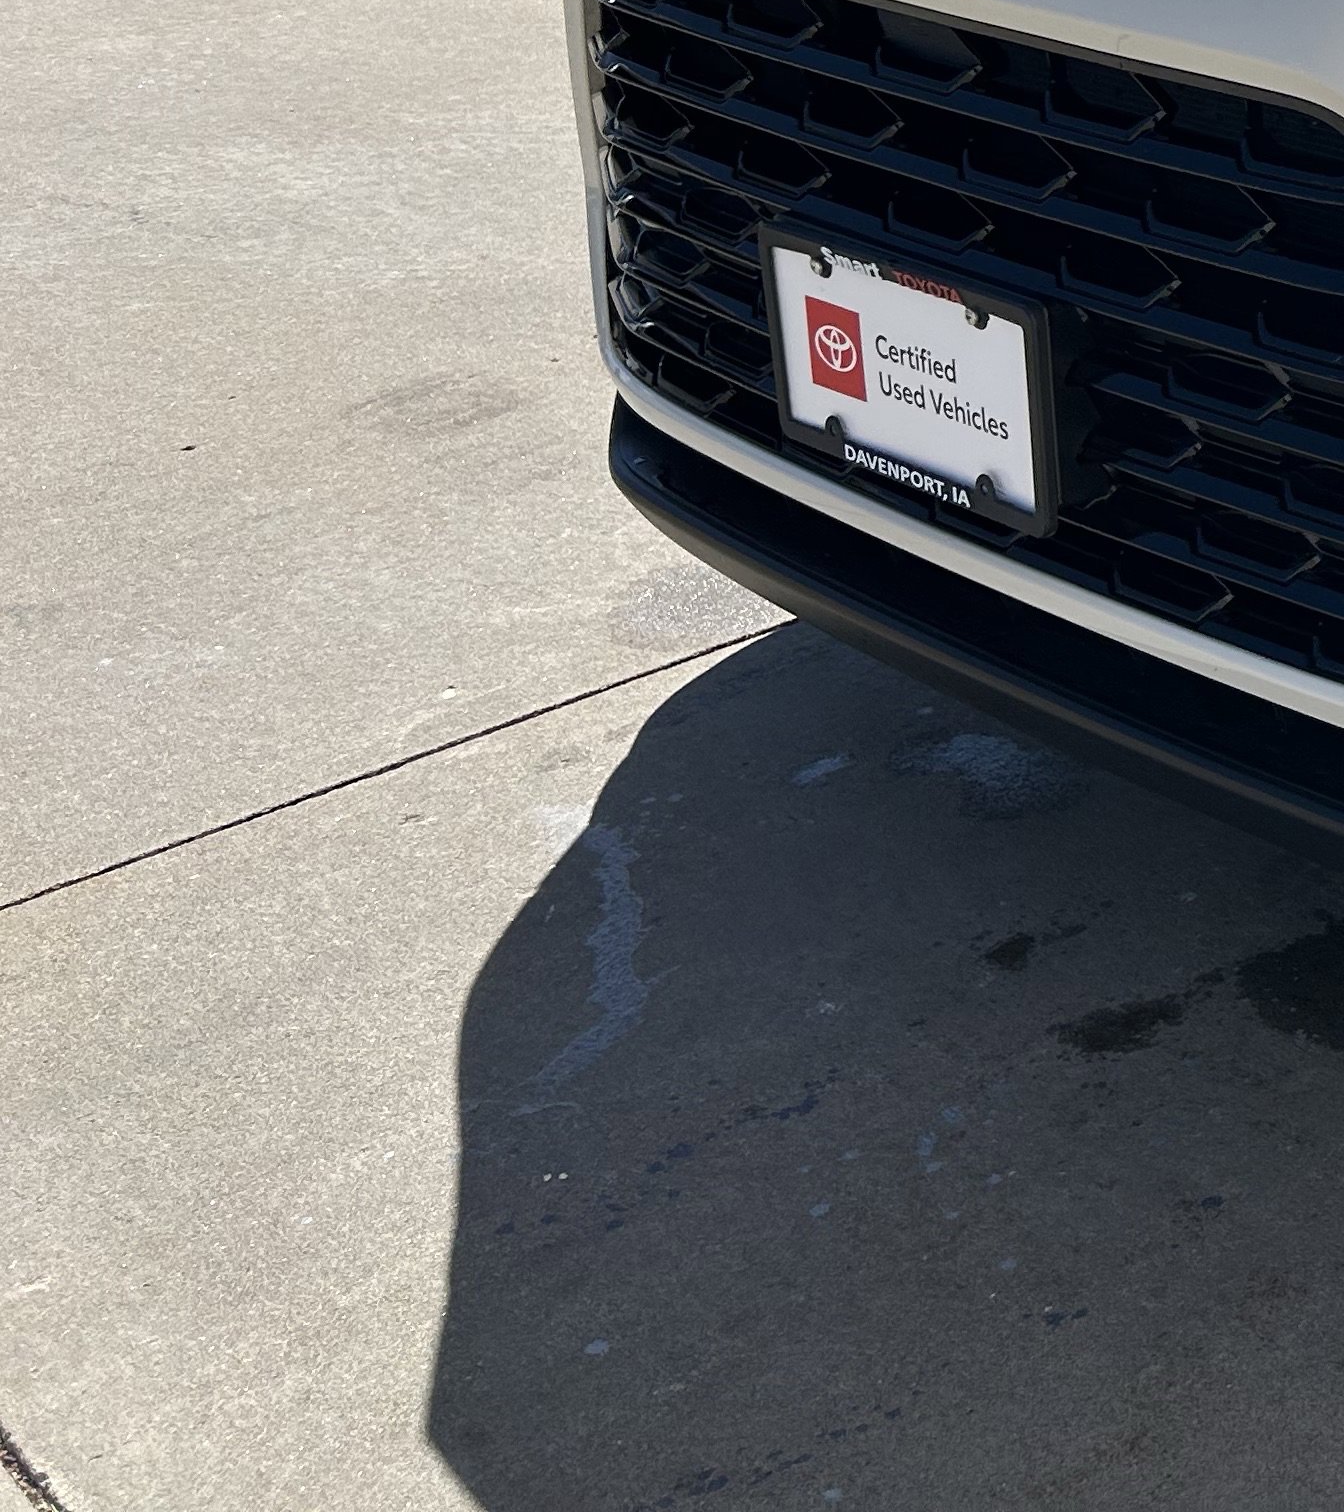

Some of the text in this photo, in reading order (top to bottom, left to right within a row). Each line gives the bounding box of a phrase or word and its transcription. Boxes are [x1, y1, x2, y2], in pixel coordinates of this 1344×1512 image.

[820, 246, 963, 303] Smart TOYOTA
[875, 335, 957, 383] Certified
[879, 371, 1009, 439] Used Vehicles
[844, 444, 971, 508] DAVENPORT, IA
